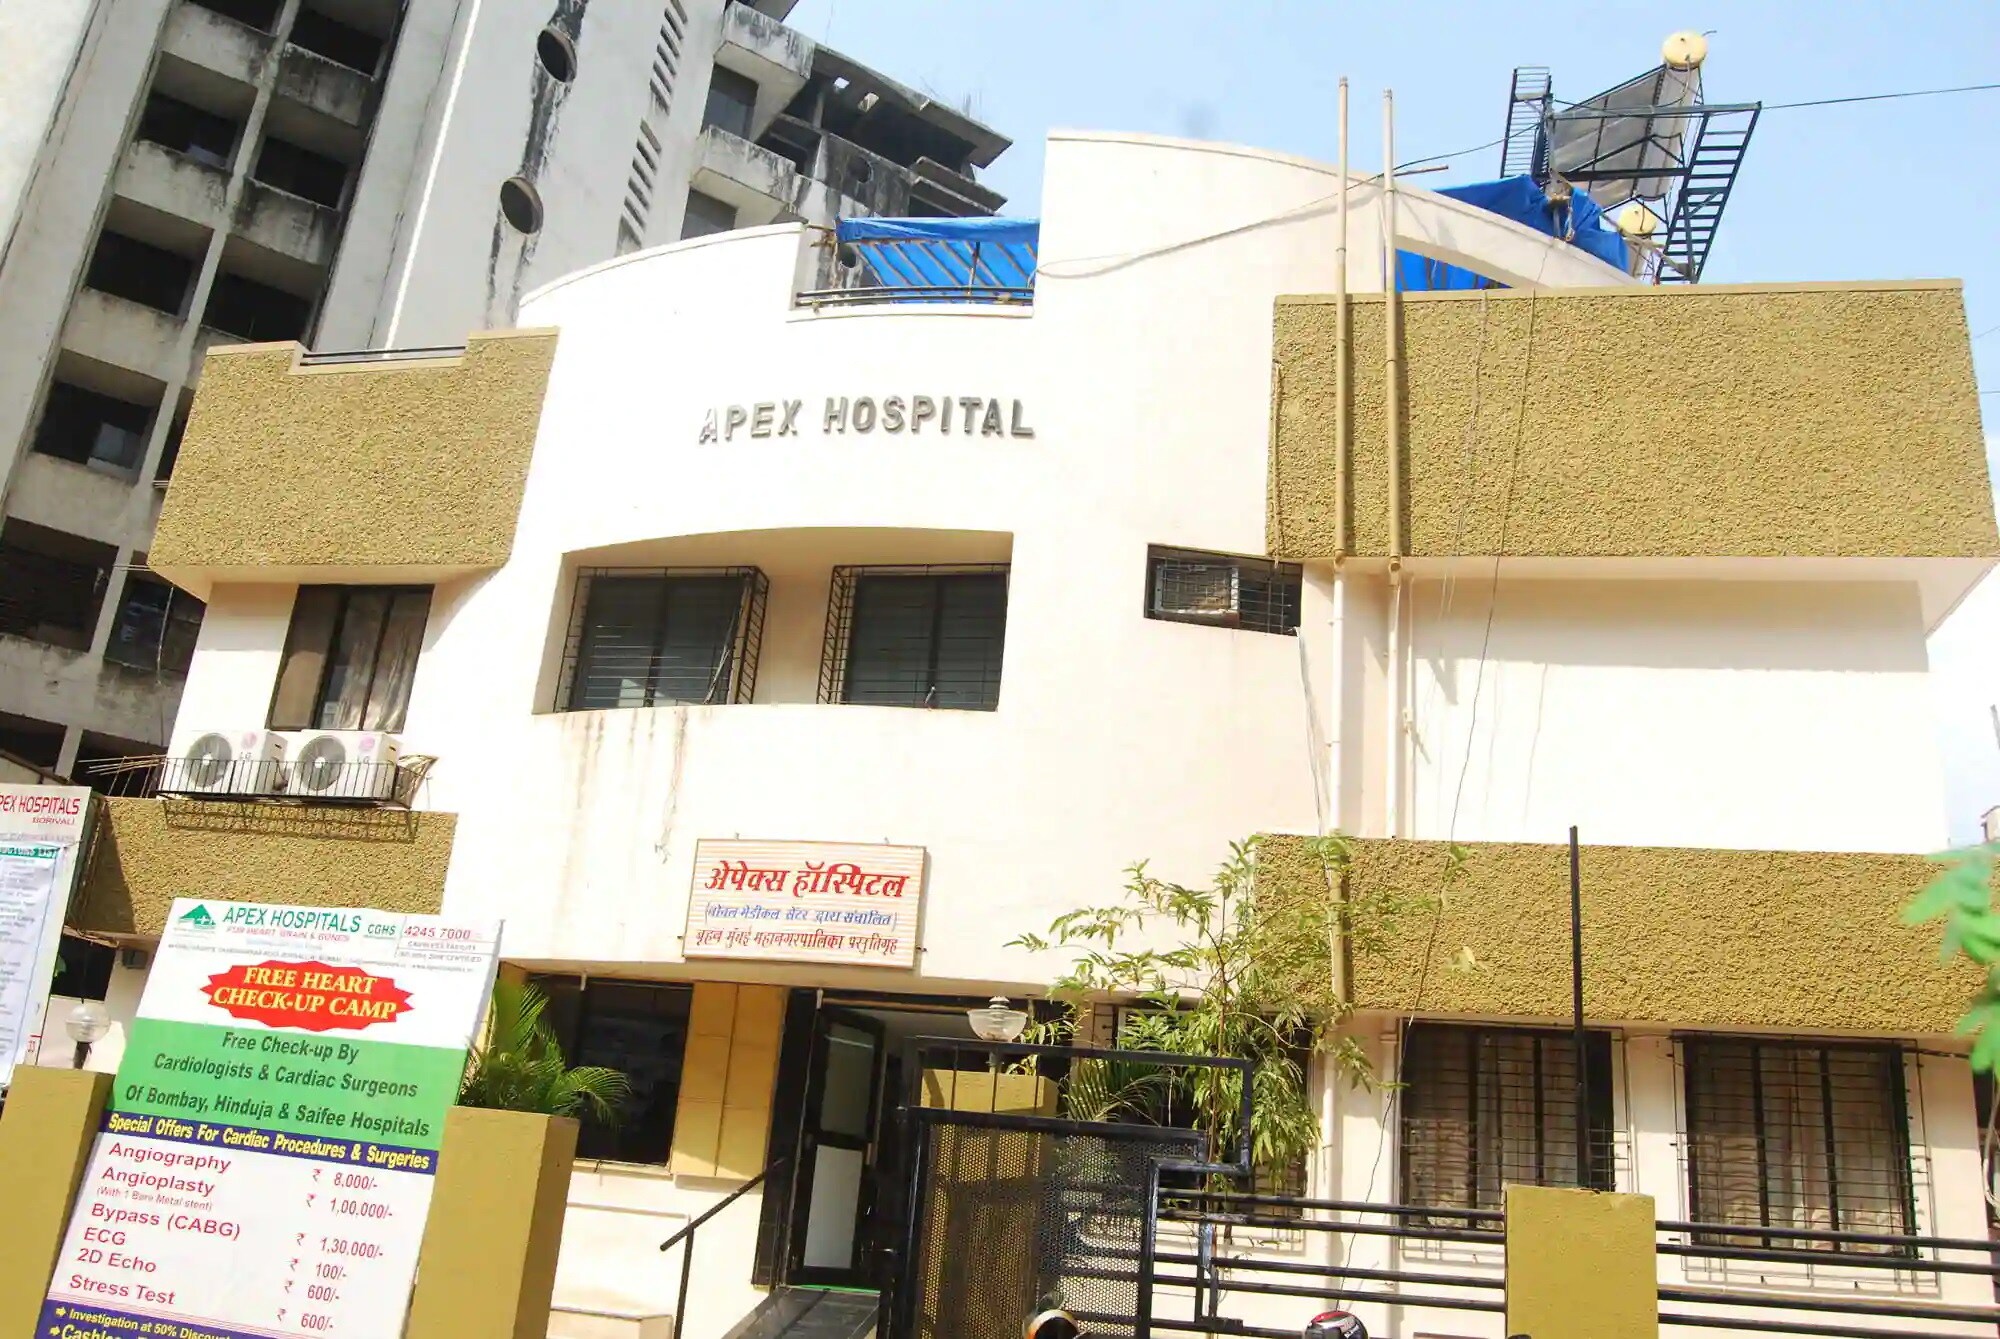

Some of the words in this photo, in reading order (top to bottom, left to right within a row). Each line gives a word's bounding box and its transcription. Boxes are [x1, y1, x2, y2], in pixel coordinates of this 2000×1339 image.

[699, 398, 802, 443] APEX
[822, 395, 1036, 437] HOSPITAL
[18, 796, 81, 815] HOSPITALS
[32, 816, 75, 826] BORIVALI
[793, 861, 911, 898] हॉस्पिटल
[223, 905, 268, 926] APEX
[270, 909, 362, 933] HOSPITALS
[367, 923, 397, 936] CGHS
[404, 925, 436, 938] 4245
[439, 927, 472, 940] 7000
[243, 967, 298, 988] FREE
[300, 972, 378, 995] HEART
[213, 986, 327, 1013] CHECK-UP
[329, 996, 397, 1020] CAMP
[222, 1031, 257, 1050] Free
[261, 1036, 333, 1062] Check-up
[337, 1043, 360, 1065] By
[154, 1052, 253, 1079] Cardiologists
[258, 1063, 269, 1081] &
[275, 1066, 336, 1089] Cardiac
[340, 1073, 418, 1098] Surgeons
[126, 1084, 144, 1101] Of
[146, 1087, 208, 1113] Bombay,
[214, 1094, 273, 1120] Hinduja
[278, 1102, 289, 1120] &
[295, 1104, 346, 1127] Saifee
[350, 1110, 431, 1137] Hospitals
[108, 1113, 152, 1133] Special
[155, 1117, 194, 1139] Offers
[196, 1123, 219, 1142] For
[222, 1127, 270, 1149] Cardiac
[274, 1133, 347, 1160] Procedures
[350, 1143, 362, 1161] &
[366, 1145, 431, 1169] Surgeries
[108, 1141, 232, 1174] Angiography
[97, 1186, 121, 1198] (With
[156, 1193, 182, 1206] Metal
[101, 1166, 216, 1198] Angioplasty
[91, 1202, 160, 1226] Bypass
[167, 1212, 241, 1241] (CABG)
[84, 1226, 127, 1246] ECG
[315, 1261, 347, 1281] 100/-
[77, 1247, 103, 1264] 2D
[108, 1252, 157, 1273] Echo
[307, 1283, 340, 1303] 600/-
[69, 1273, 129, 1297] Stress
[136, 1284, 177, 1305] Test
[300, 1312, 334, 1332] 600/-
[69, 1308, 138, 1330] Investigation
[140, 1322, 153, 1333] at
[154, 1323, 177, 1337] 50%
